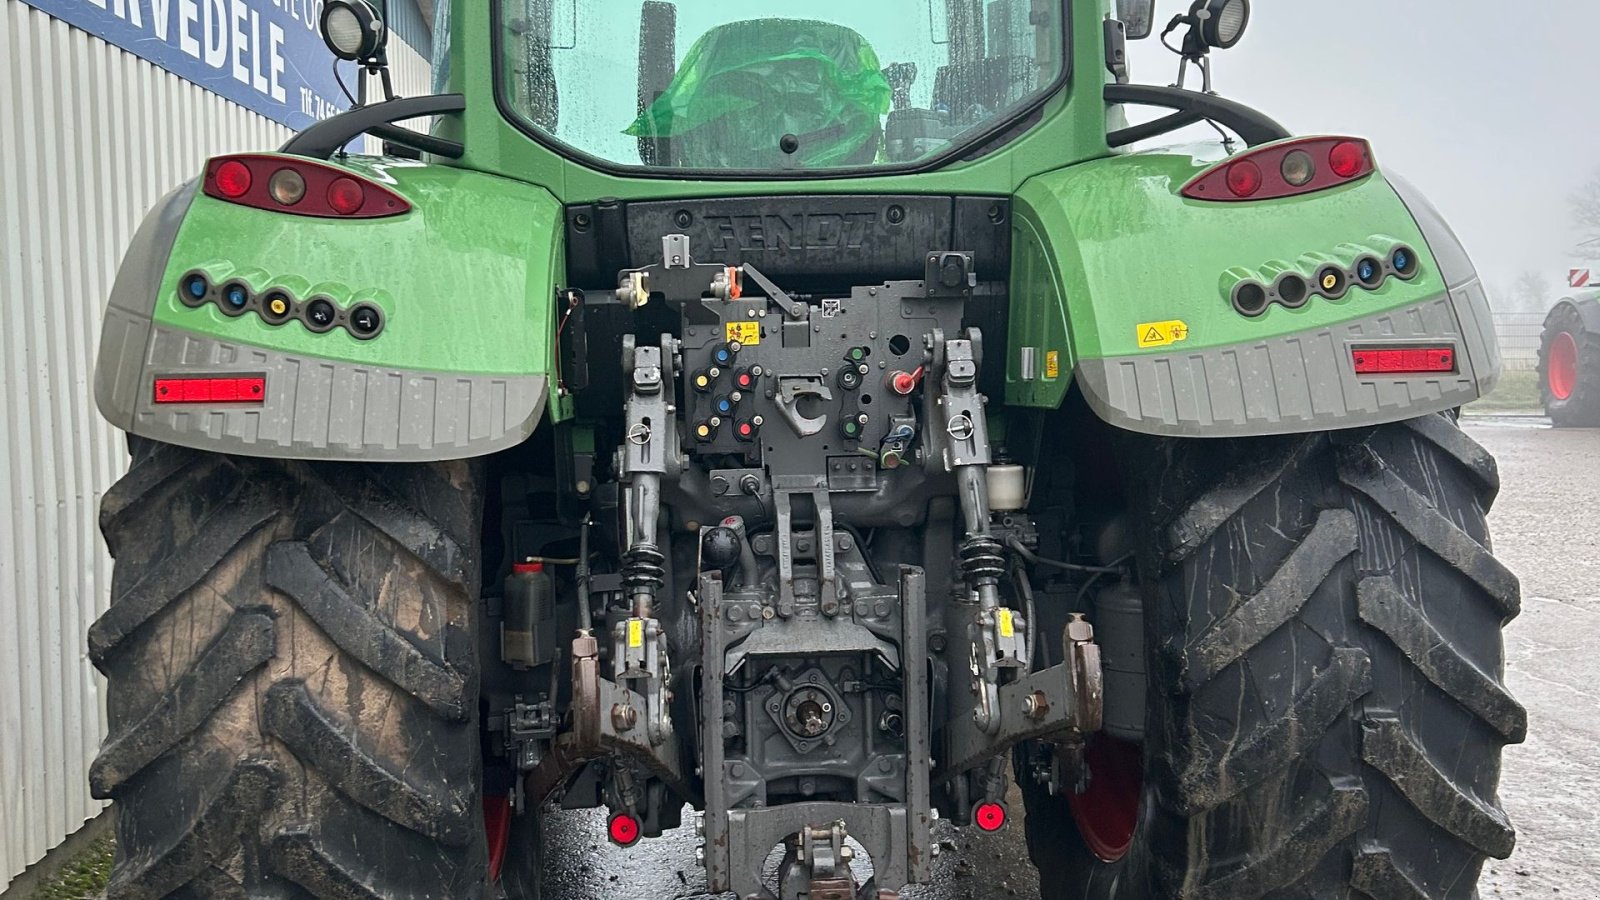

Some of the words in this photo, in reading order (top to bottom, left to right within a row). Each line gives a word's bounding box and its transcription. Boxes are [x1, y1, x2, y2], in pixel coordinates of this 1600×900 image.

[299, 86, 315, 118] Tlf.
[314, 95, 326, 121] 74
[703, 212, 877, 251] FENDT
